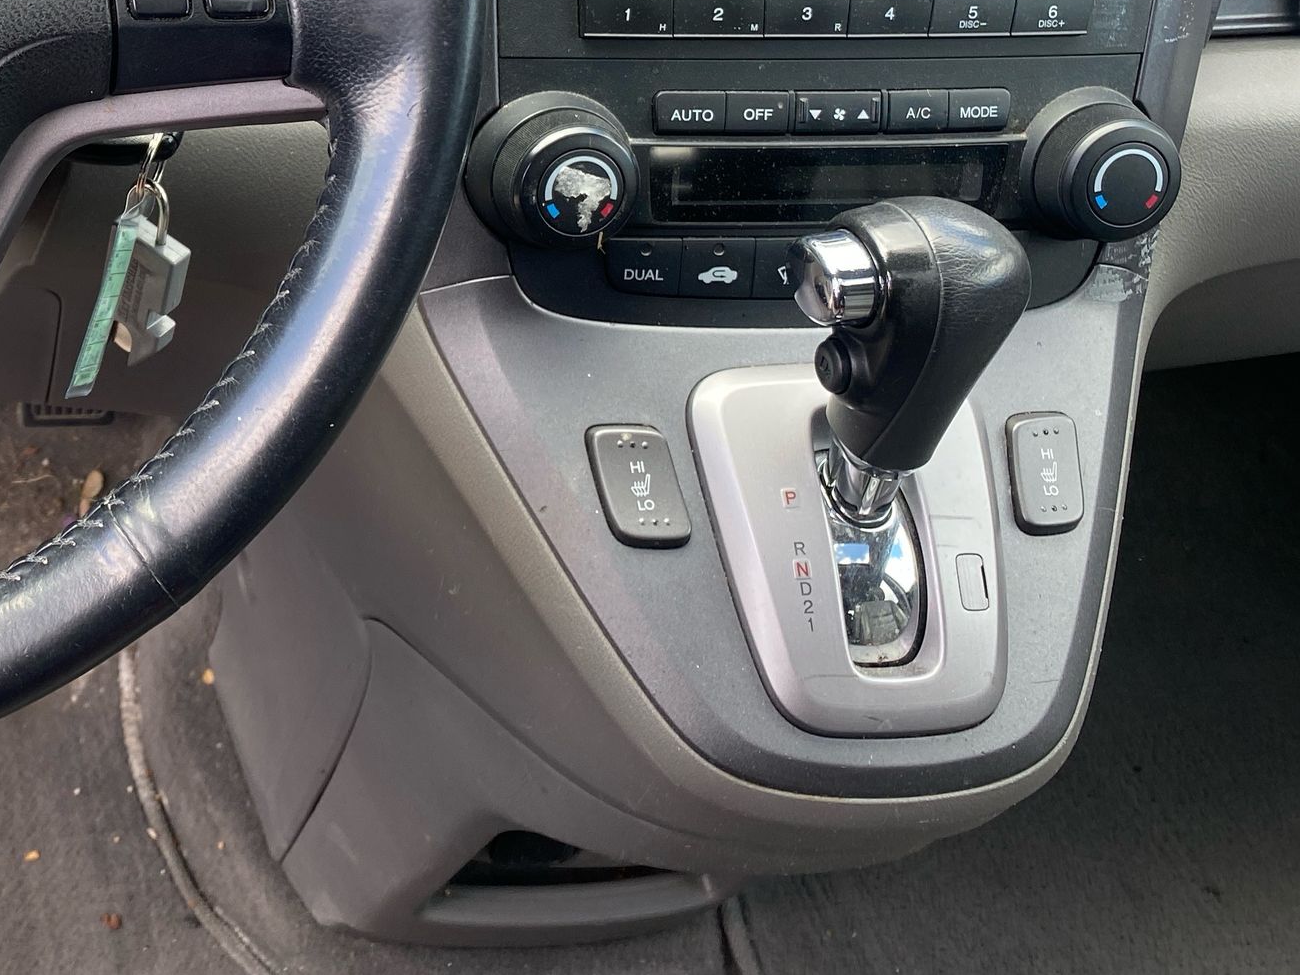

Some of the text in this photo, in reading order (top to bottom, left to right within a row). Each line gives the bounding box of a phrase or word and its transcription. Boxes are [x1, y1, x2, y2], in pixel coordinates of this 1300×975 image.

[624, 8, 631, 22] 1
[712, 8, 724, 21] 2
[801, 7, 813, 21] 3
[884, 6, 895, 20] 4
[968, 6, 978, 20] 5
[1048, 5, 1058, 18] 6
[659, 23, 666, 31] H
[750, 23, 759, 32] M
[834, 23, 841, 32] R
[671, 109, 714, 122] AUTO
[743, 109, 773, 121] OFF
[906, 107, 931, 119] A/C
[960, 106, 998, 118] MODE
[624, 268, 664, 282] DUAL
[1041, 448, 1054, 460] HI
[630, 460, 645, 474] HI
[1043, 485, 1059, 496] LO
[785, 491, 796, 505] P
[637, 499, 655, 511] LO
[794, 542, 806, 556] R
[795, 561, 810, 577] N
[800, 582, 812, 596] D
[804, 600, 815, 614] 2
[808, 618, 815, 632] 1
